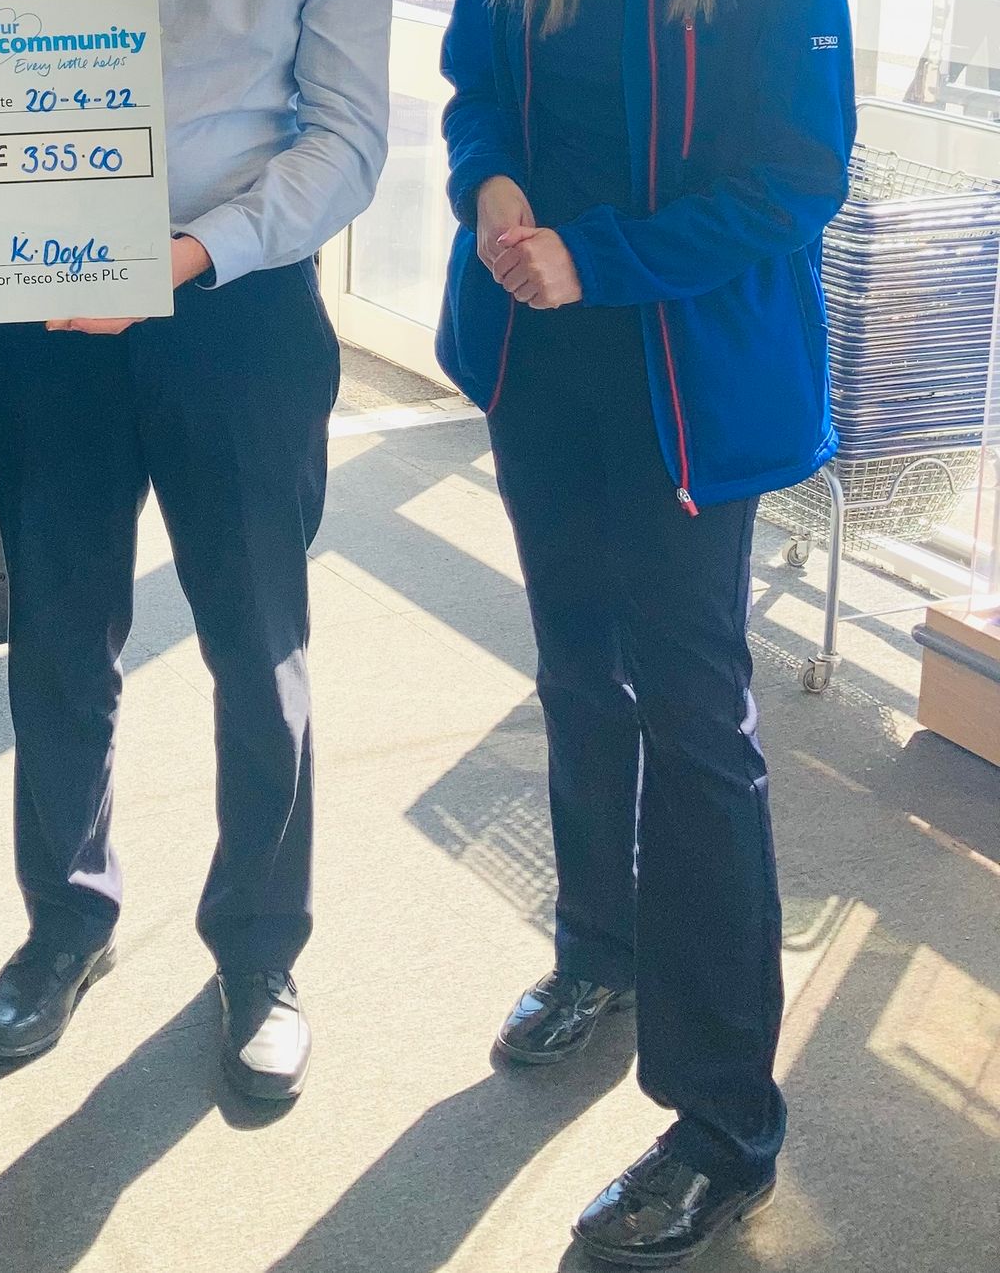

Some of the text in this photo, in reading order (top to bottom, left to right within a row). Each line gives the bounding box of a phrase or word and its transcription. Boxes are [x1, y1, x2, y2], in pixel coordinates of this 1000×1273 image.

[811, 35, 838, 47] TESCO
[14, 55, 127, 77] Every little helps
[14, 272, 53, 285] Tesco
[56, 270, 98, 284] Stores
[102, 268, 129, 281] PLC
